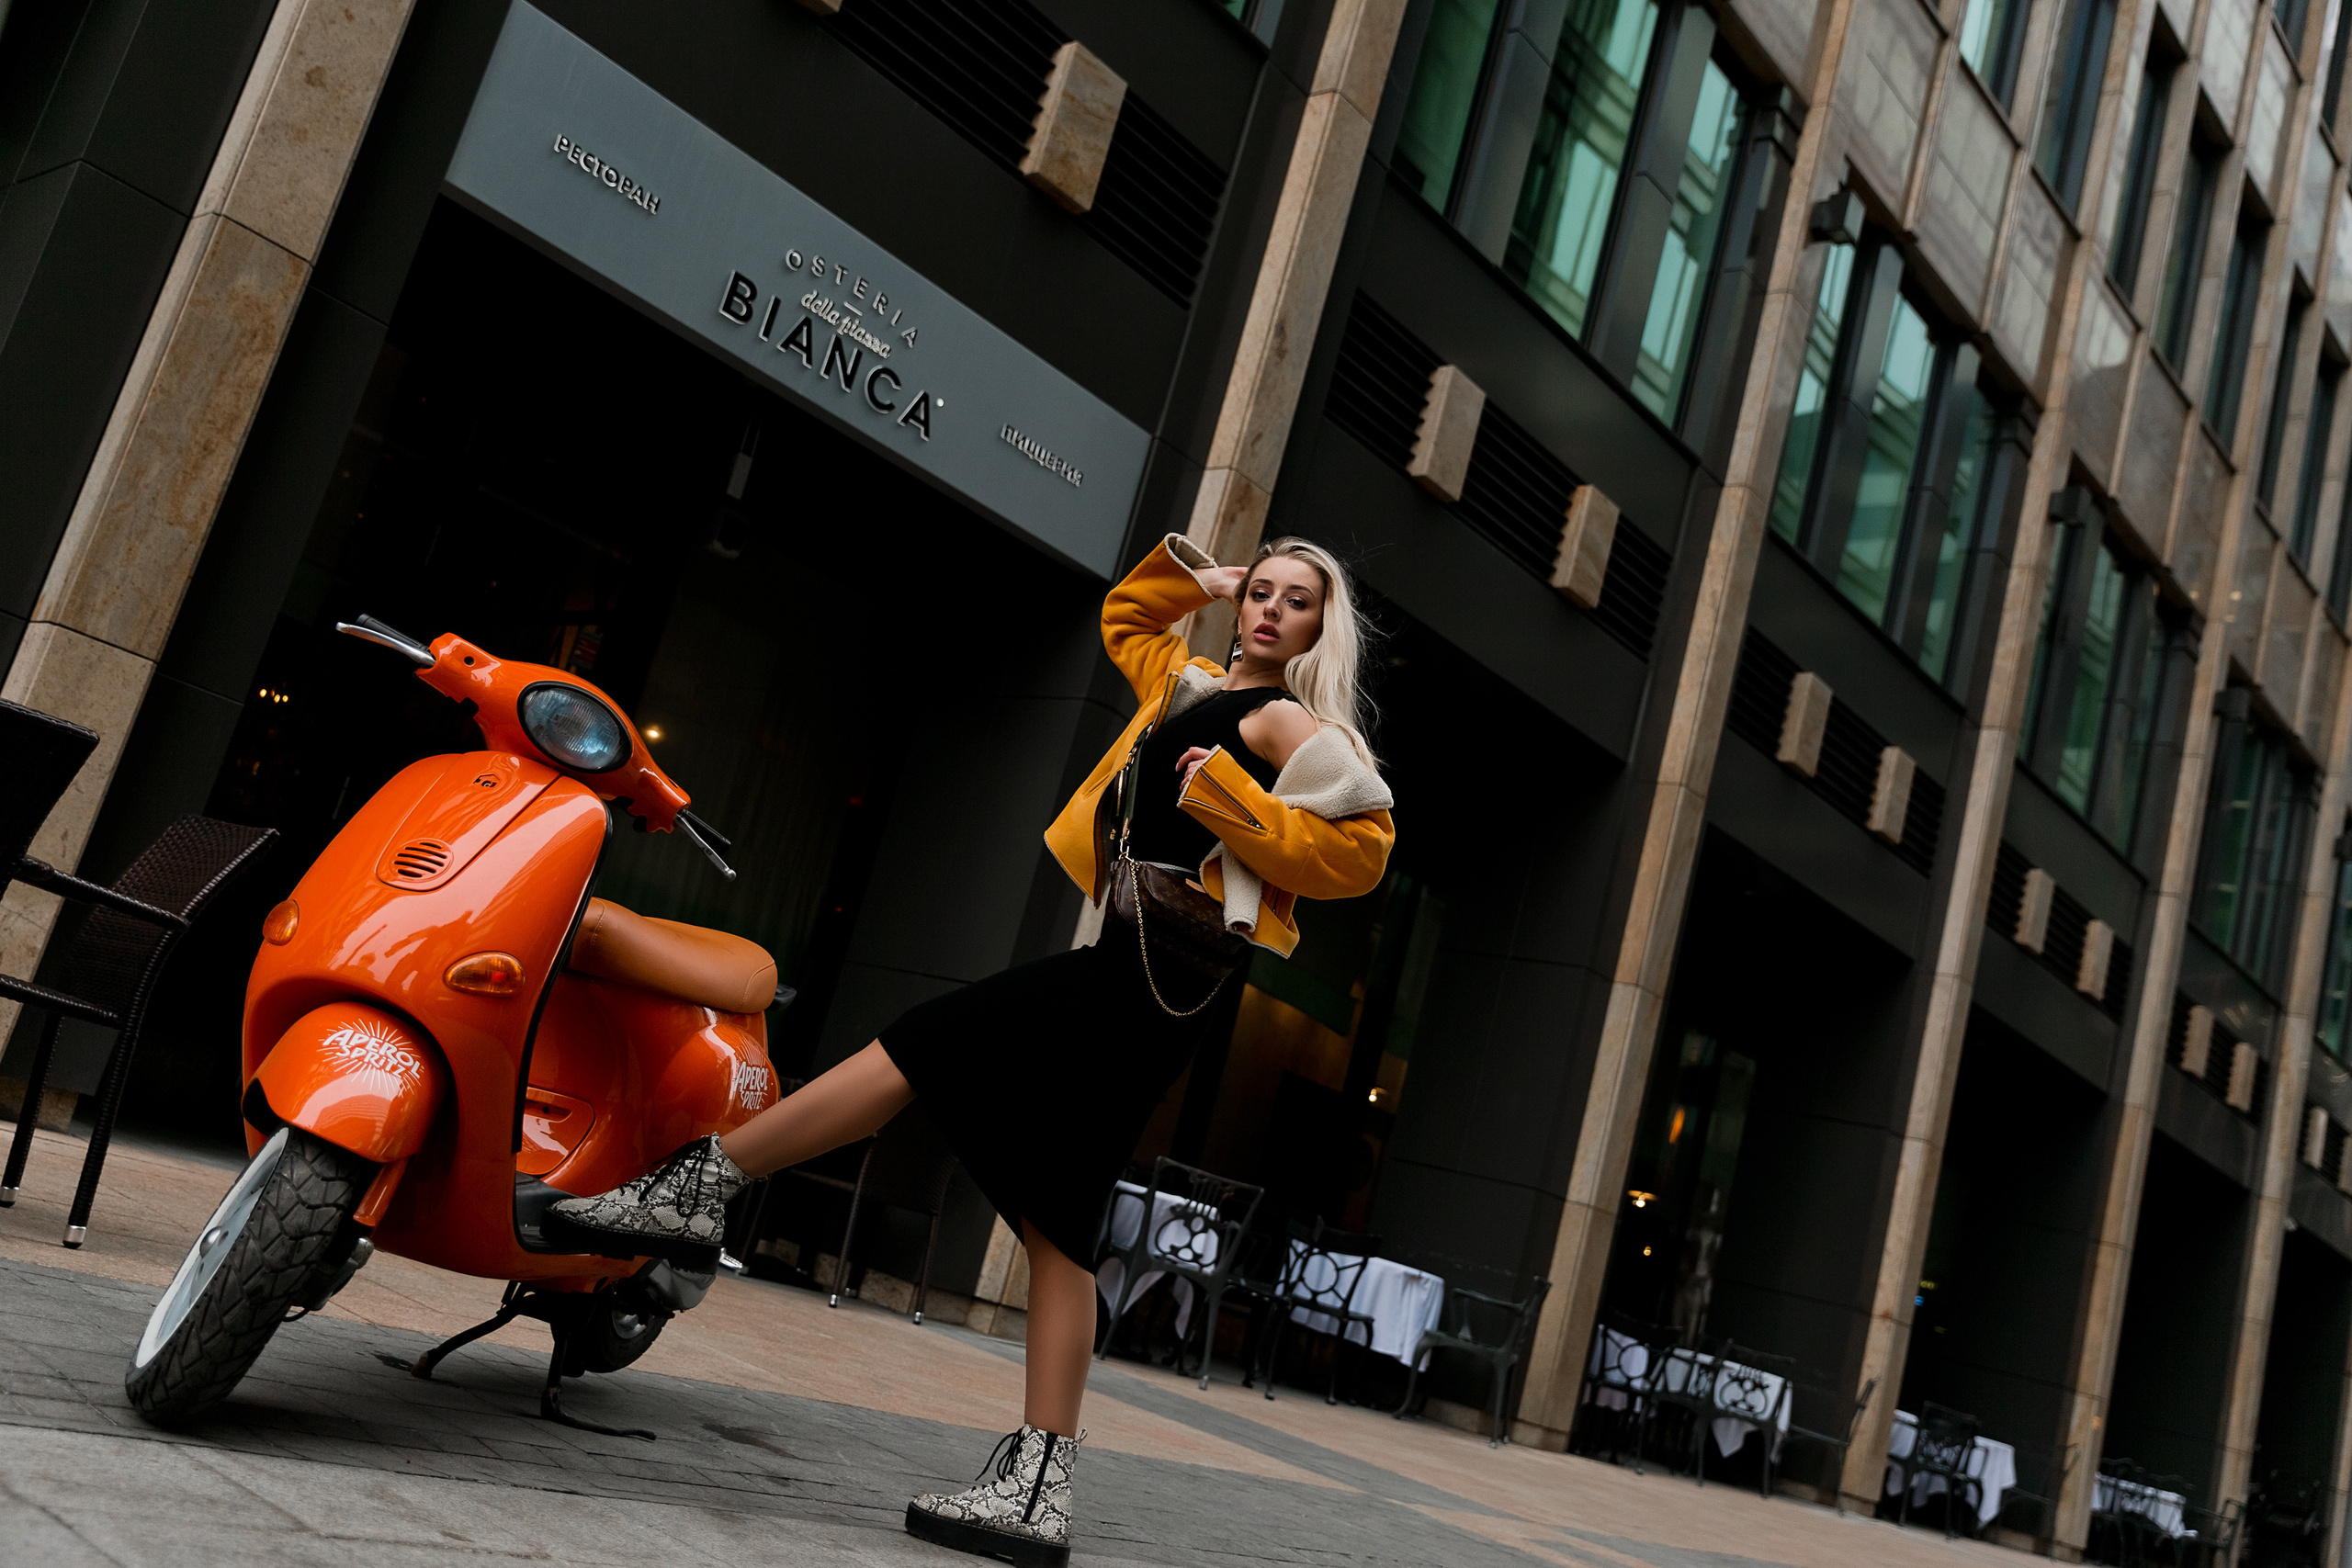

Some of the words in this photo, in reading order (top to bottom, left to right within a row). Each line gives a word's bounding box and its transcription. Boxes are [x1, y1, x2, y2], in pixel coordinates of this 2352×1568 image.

[553, 133, 662, 215] РЕСТОРАН
[786, 249, 918, 348] OSTERIA
[801, 289, 841, 326] della
[718, 269, 931, 442] BIANCA
[1001, 423, 1084, 488] ПИЦЦЕРИЯ
[322, 1029, 421, 1078] APEROL
[733, 1061, 768, 1091] APEROL
